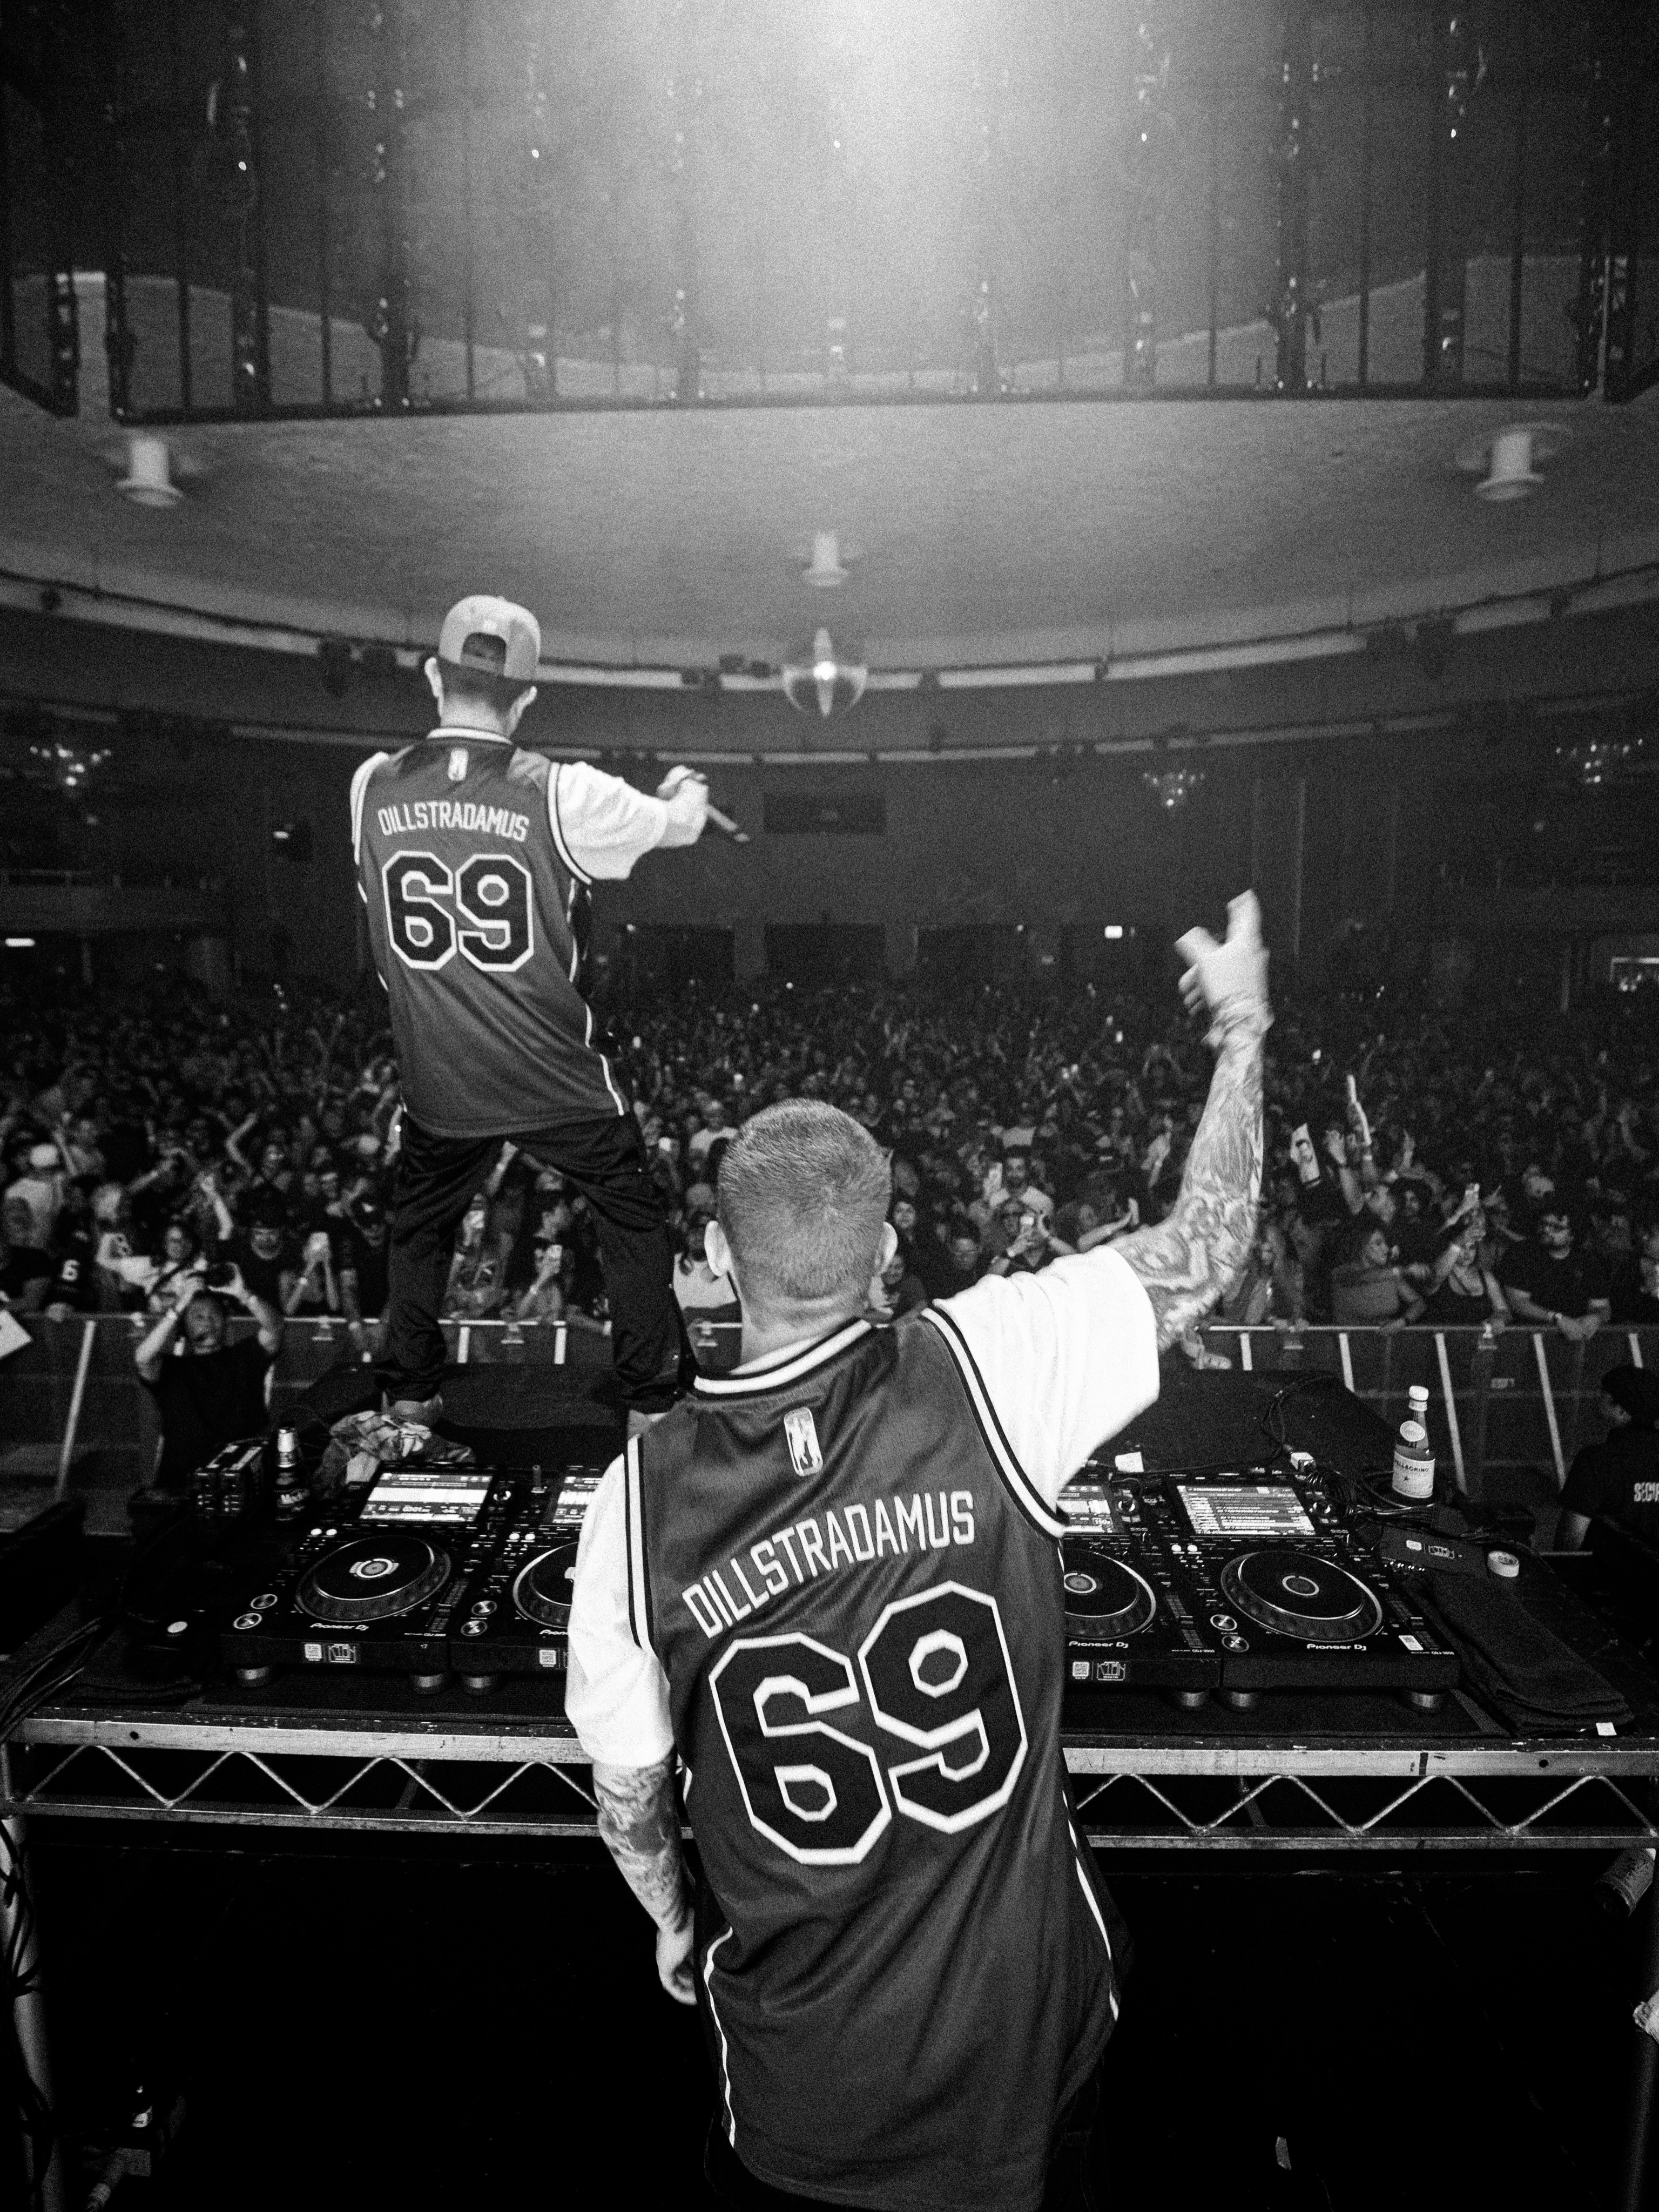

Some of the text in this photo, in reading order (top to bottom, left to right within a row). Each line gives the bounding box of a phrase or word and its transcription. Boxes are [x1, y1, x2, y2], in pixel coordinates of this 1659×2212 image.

[377, 800, 530, 842] DILLSTRADAMUS
[382, 850, 534, 972] 69
[682, 1490, 975, 1638] DILLSTRADAMUS
[709, 1580, 1028, 1865] 69
